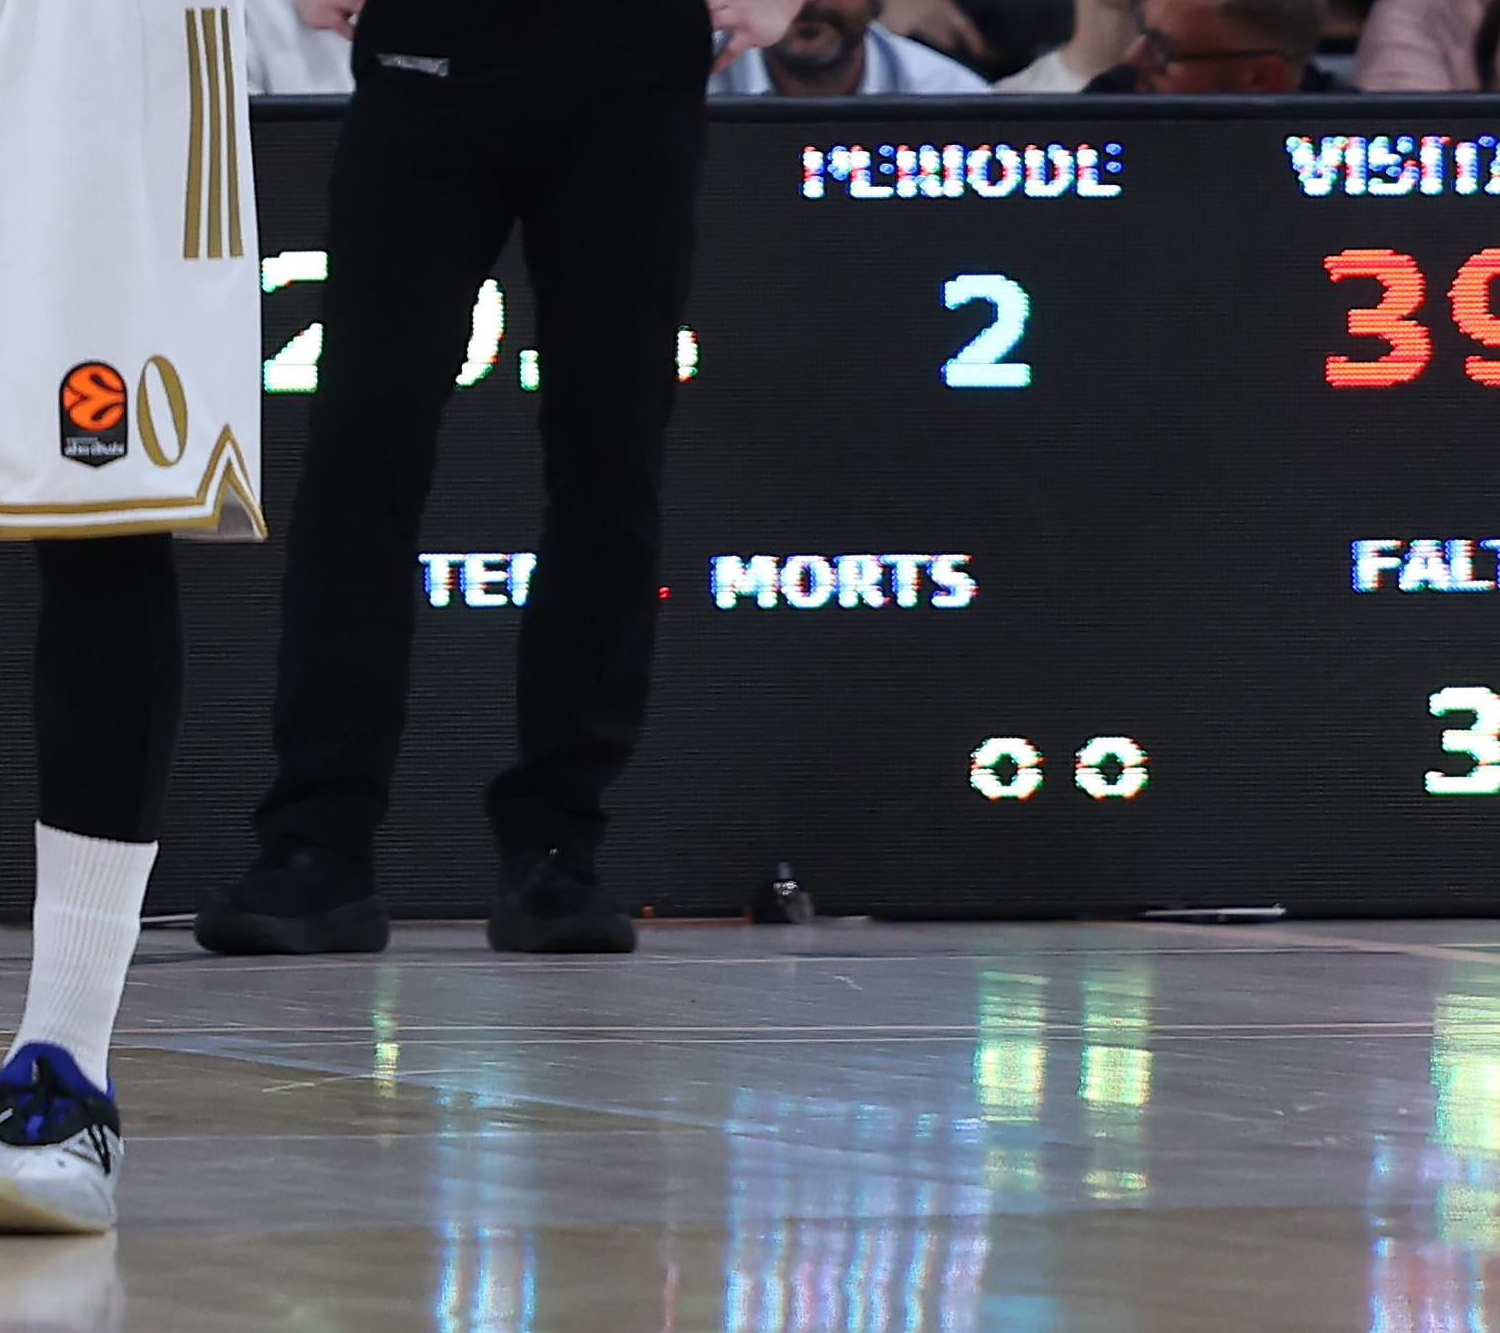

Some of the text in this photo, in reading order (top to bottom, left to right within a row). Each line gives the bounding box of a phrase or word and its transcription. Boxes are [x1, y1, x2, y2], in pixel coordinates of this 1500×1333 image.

[941, 274, 1032, 388] 2
[136, 355, 188, 467] 0
[710, 554, 978, 608] MORTS
[1425, 686, 1500, 794] 3
